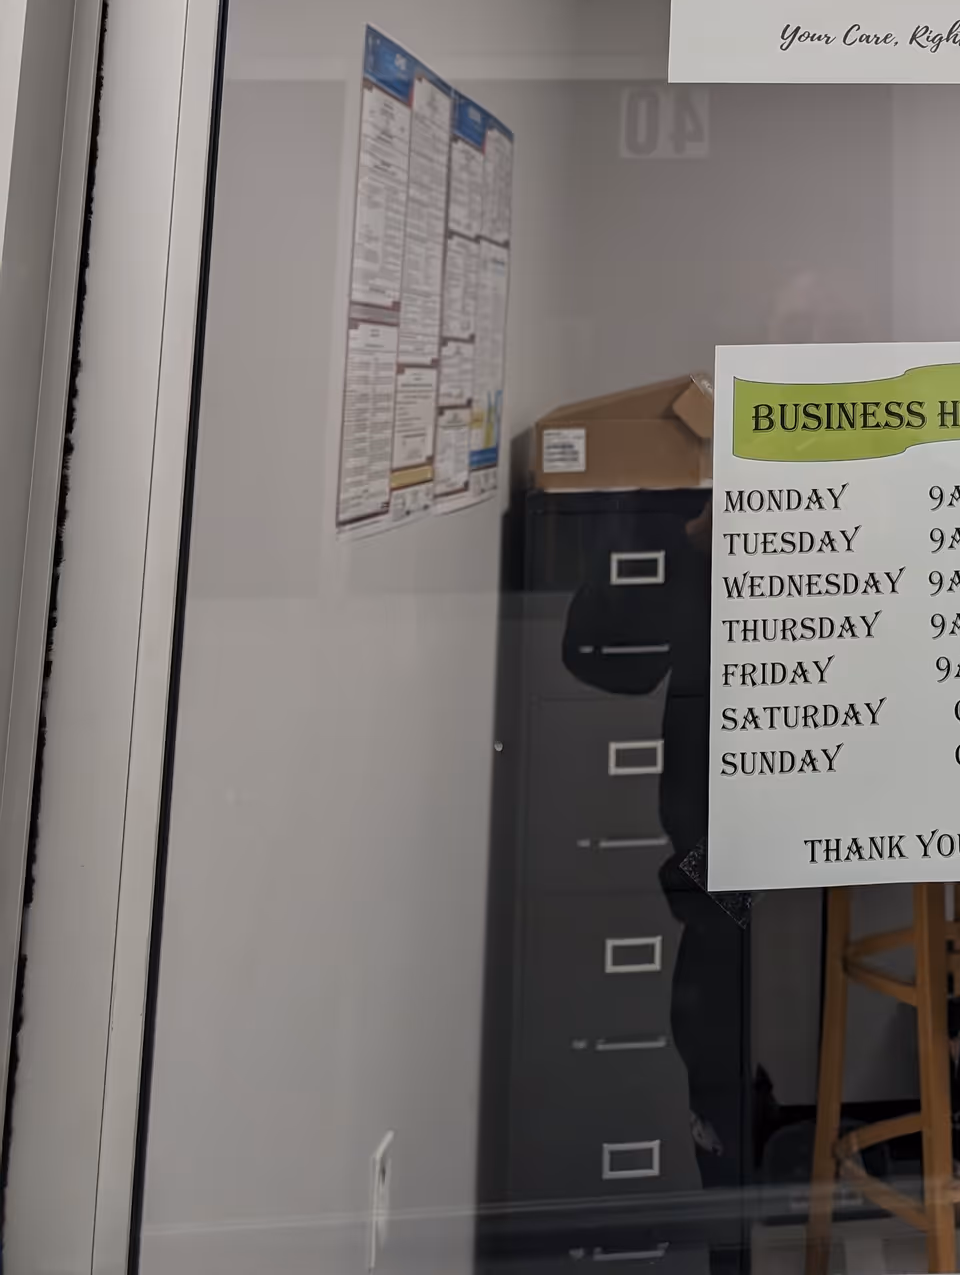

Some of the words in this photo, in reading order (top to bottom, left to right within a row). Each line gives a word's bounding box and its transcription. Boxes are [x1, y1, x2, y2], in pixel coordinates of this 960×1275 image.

[780, 24, 836, 51] Your
[842, 24, 899, 48] Care,
[751, 400, 927, 433] BUSINESS
[724, 483, 849, 514] MONDAY
[723, 525, 862, 556] TUESDAY
[723, 566, 906, 599] WEDNESDAY
[722, 610, 883, 642] THURSDAY
[722, 654, 835, 687] FRIDAY
[721, 697, 887, 731] SATURDAY
[721, 743, 844, 776] SUNDAY
[805, 833, 906, 863] THANK
